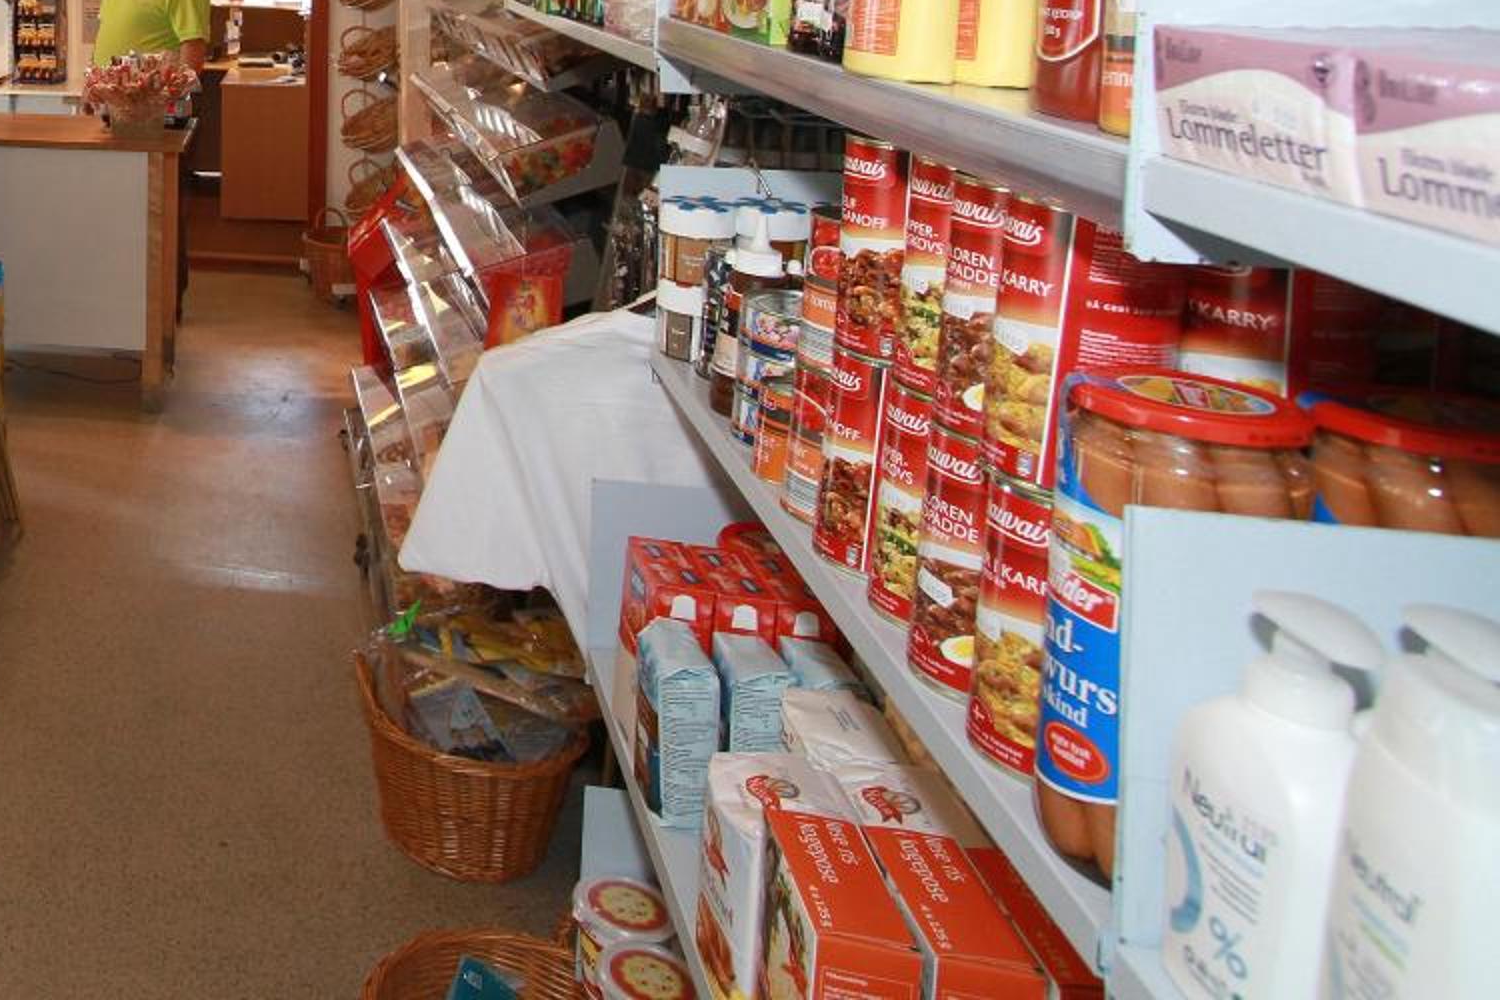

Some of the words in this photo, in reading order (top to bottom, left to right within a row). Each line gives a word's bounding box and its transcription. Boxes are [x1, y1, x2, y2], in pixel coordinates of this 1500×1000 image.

[1166, 107, 1328, 171] Lommeletter
[1003, 269, 1051, 297] KARRY
[1197, 301, 1272, 330] KARRY
